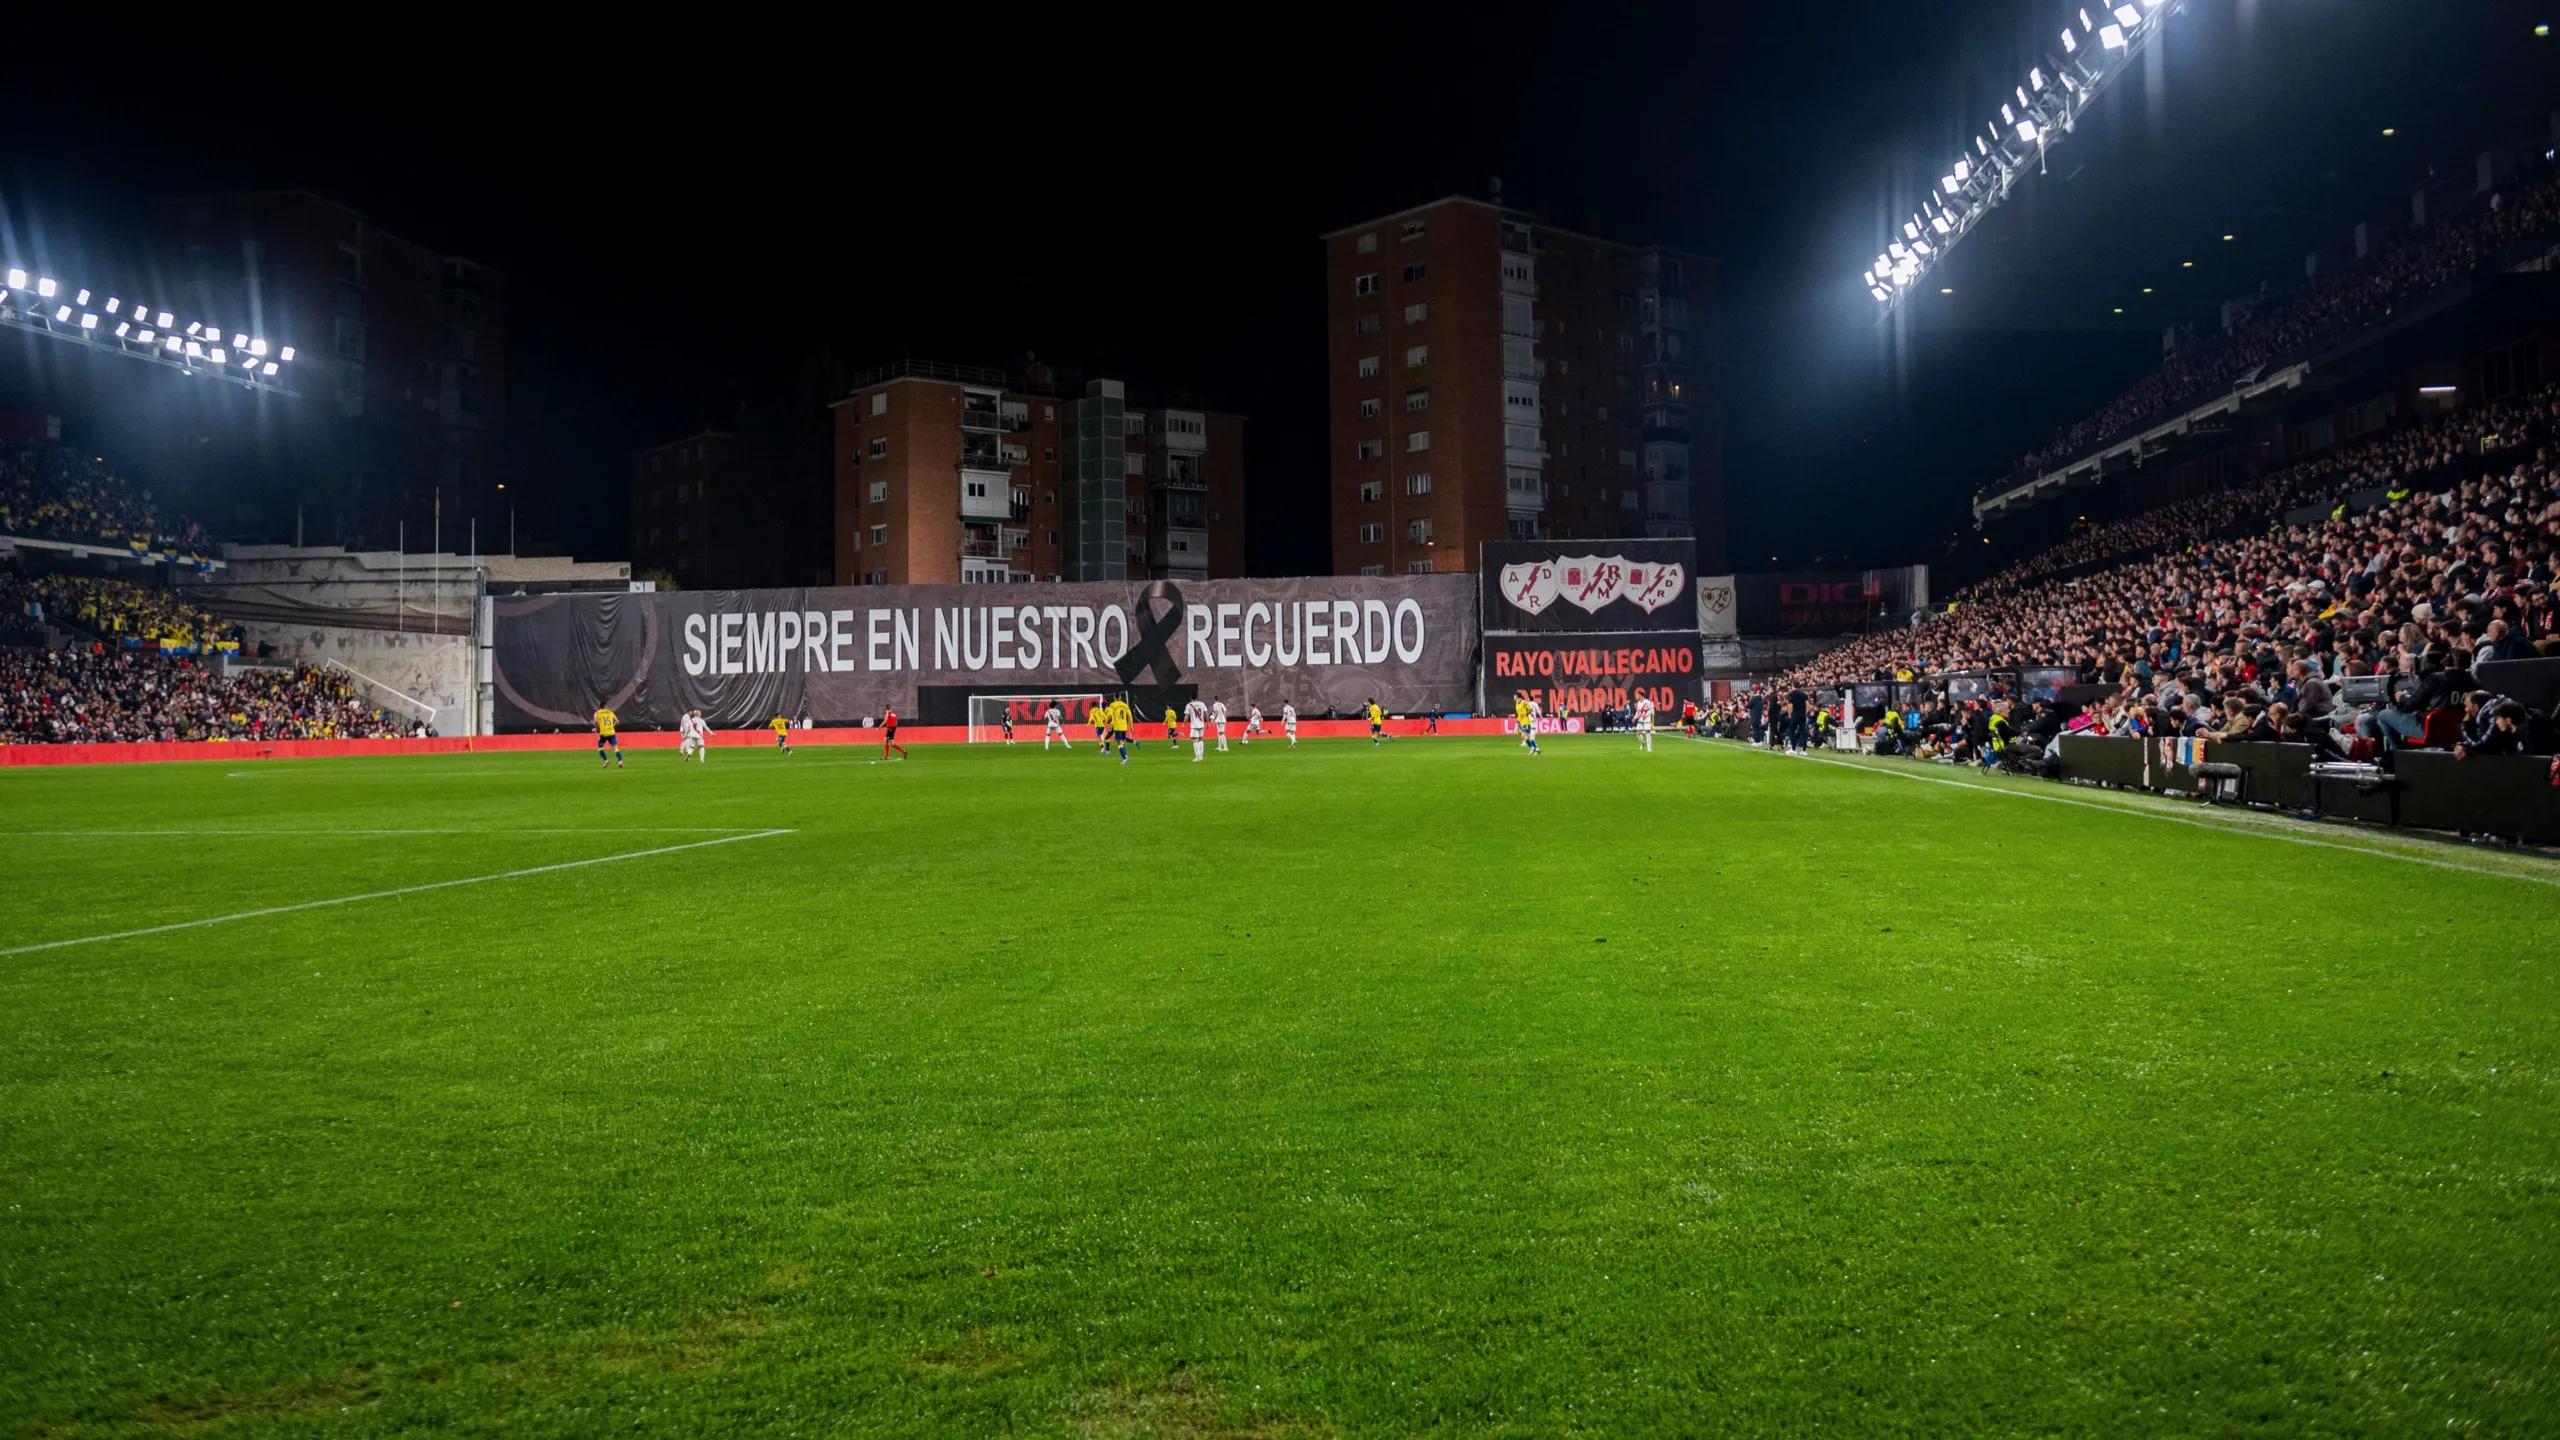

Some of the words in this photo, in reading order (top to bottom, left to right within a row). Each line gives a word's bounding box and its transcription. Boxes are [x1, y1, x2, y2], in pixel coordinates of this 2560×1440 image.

[683, 610, 855, 676] SIEMPRE
[868, 607, 919, 671] EN
[934, 604, 1129, 670] NUESTRO
[1187, 598, 1425, 668] RECUERDO
[1496, 650, 1554, 676] RAYO
[1561, 647, 1693, 675] VALLECANO
[1549, 687, 1628, 713] MADRID
[1634, 686, 1675, 712] SAD
[1504, 717, 1562, 734] LIGA
